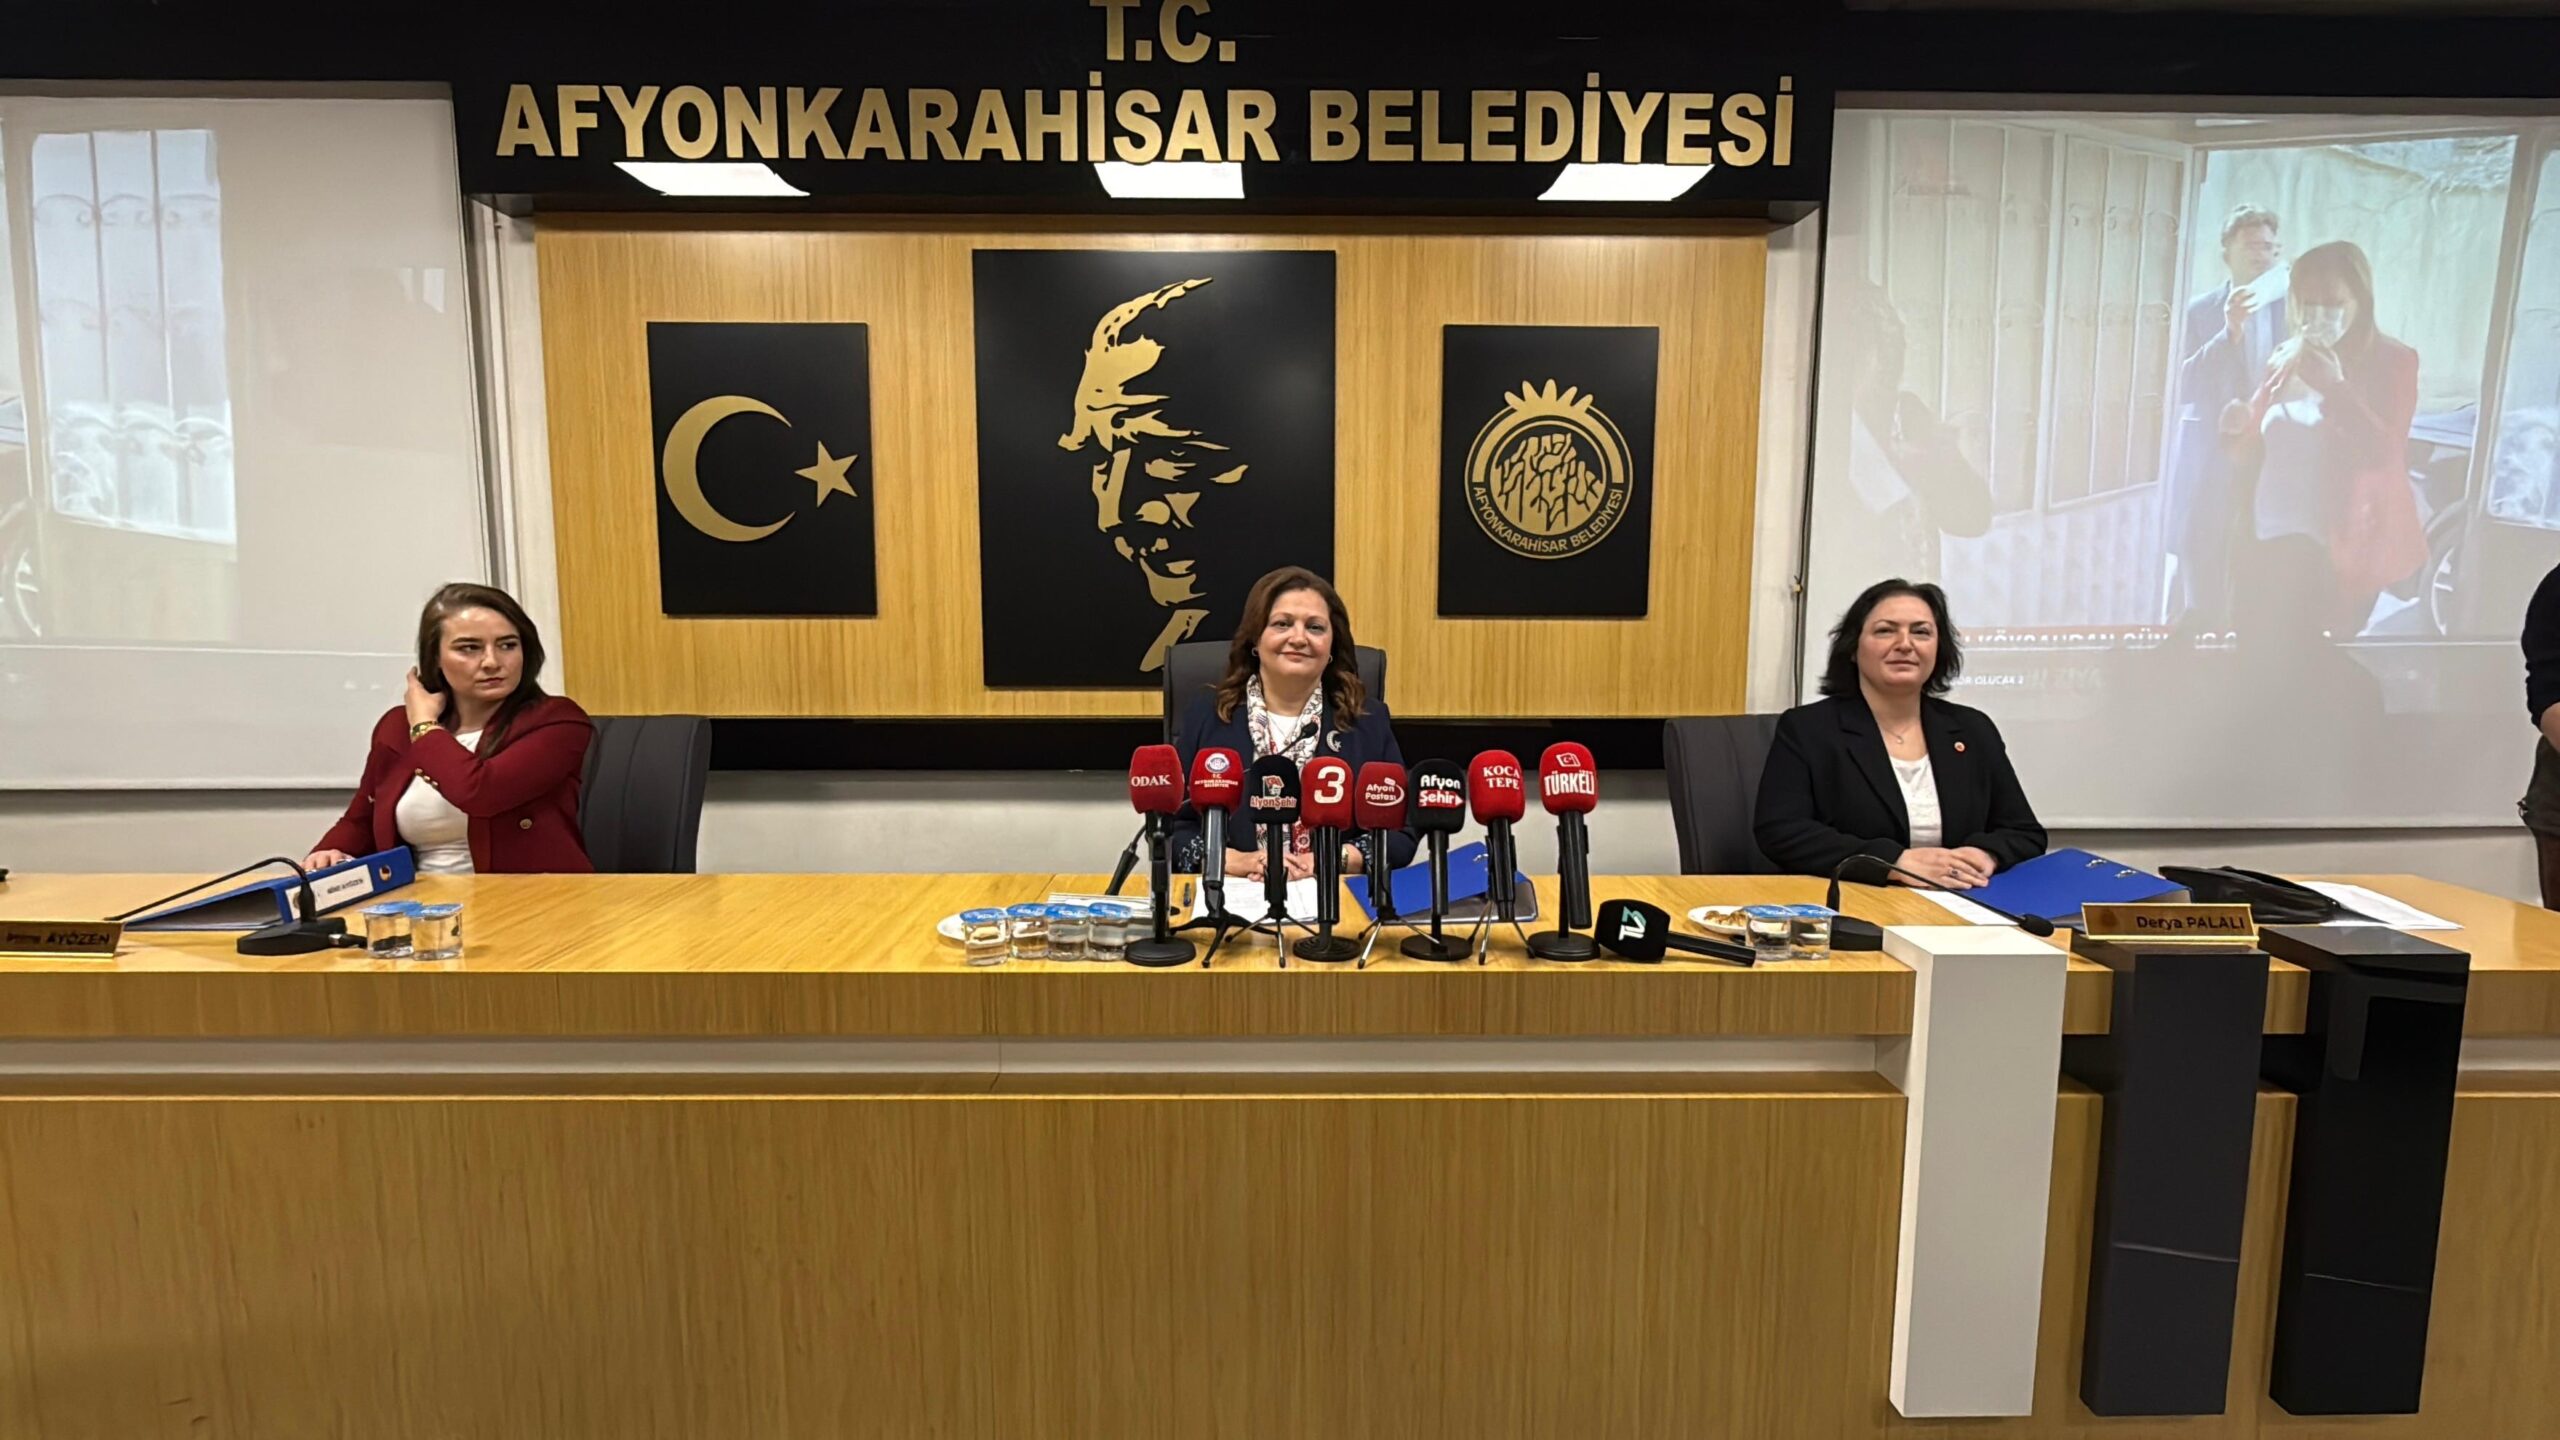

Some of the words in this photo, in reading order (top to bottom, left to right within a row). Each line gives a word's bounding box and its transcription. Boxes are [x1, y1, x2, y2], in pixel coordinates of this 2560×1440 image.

[1089, 0, 1236, 63] T.C.
[496, 71, 1280, 165] AFYONKARAHİSAR
[1309, 72, 1793, 166] BELEDİYESİ
[1473, 486, 1568, 553] AFYONKARAHİSAR
[1483, 765, 1520, 779] KOCA
[1131, 774, 1171, 787] ODAK
[1314, 766, 1346, 803] 3
[1366, 784, 1395, 793] Afyon
[1421, 774, 1461, 790] Afyon
[1486, 777, 1520, 790] TEPE
[1419, 790, 1457, 807] Şehir
[2136, 915, 2183, 931] Derya
[2186, 916, 2245, 930] PALALI
